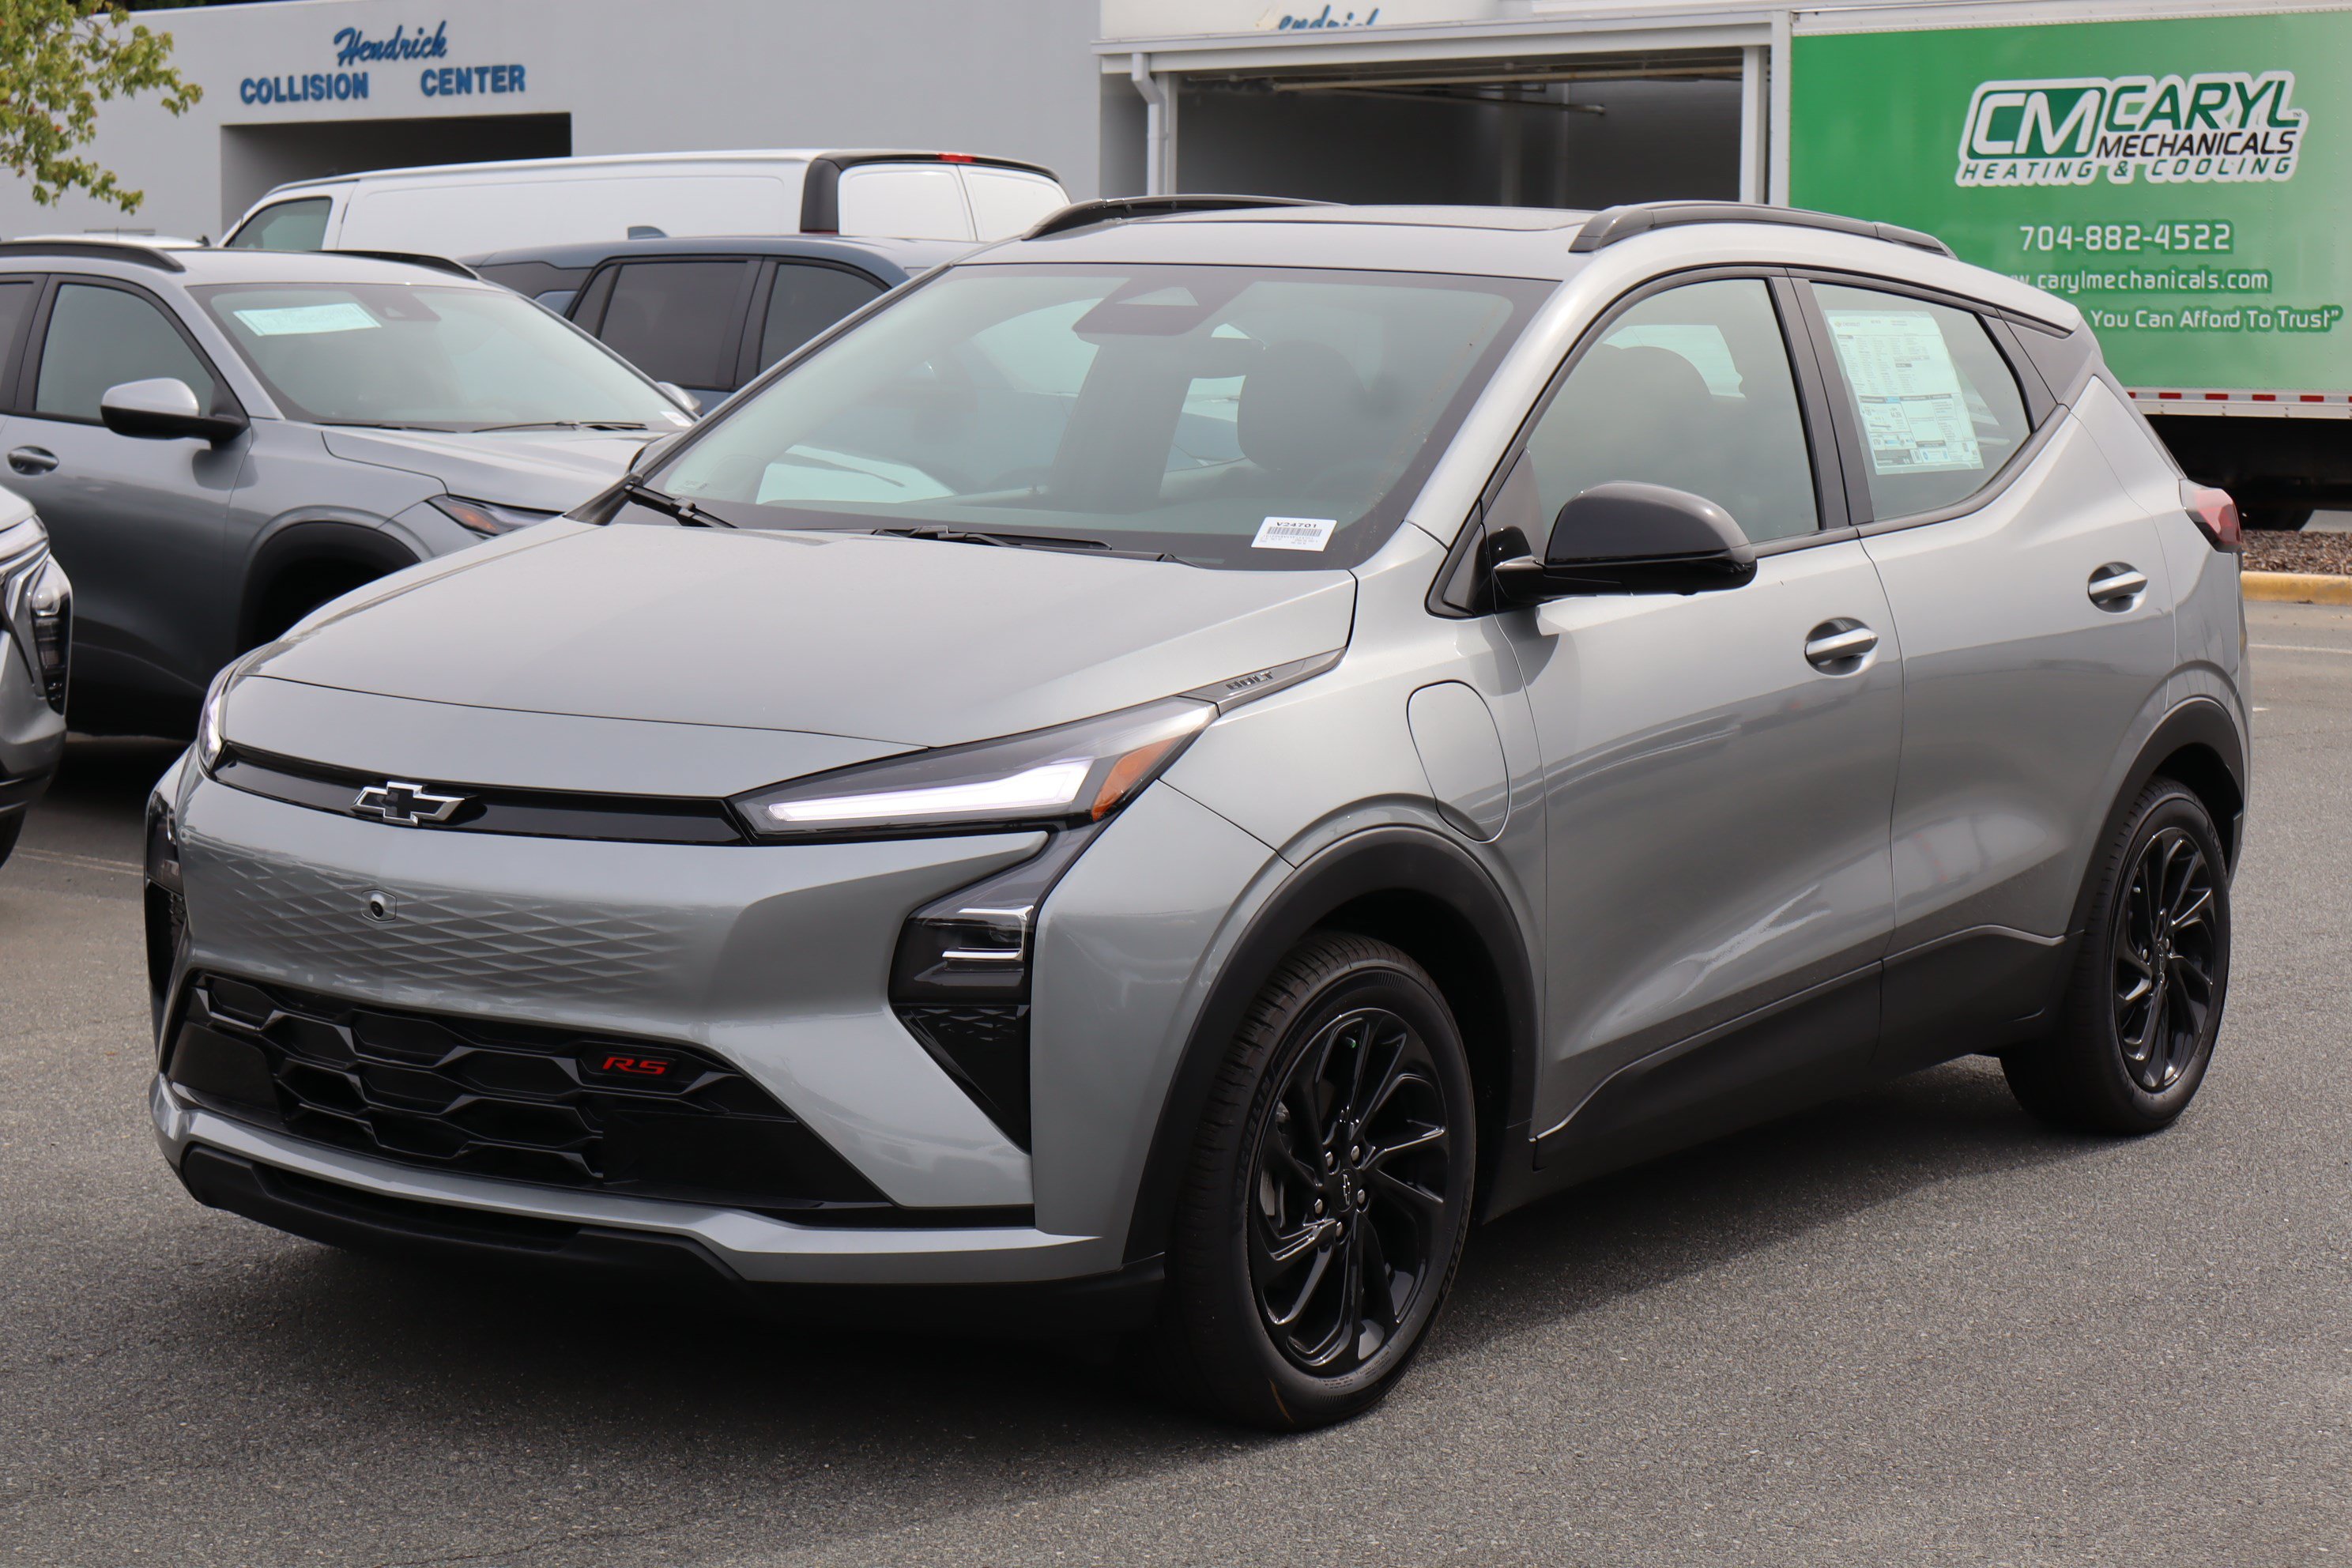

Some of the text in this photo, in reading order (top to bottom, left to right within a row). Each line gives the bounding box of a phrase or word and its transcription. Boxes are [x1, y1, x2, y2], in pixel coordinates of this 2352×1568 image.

[334, 21, 447, 66] Hendrick
[240, 64, 526, 104] COLLISION CENTER
[2105, 80, 2300, 132] CARYL
[1973, 89, 2102, 155] CM
[2096, 130, 2297, 158] MECHANICALS
[1962, 157, 2292, 179] HEATING & COOLING
[2020, 224, 2230, 251] 704-882-4522
[2010, 270, 2268, 293] w.carylmechanicals.com
[2090, 310, 2129, 328] You
[2135, 310, 2173, 327] Can
[2180, 309, 2241, 328] Afford
[2246, 310, 2271, 327] To
[1225, 671, 1274, 690] BOLT
[602, 1057, 668, 1074] RS
